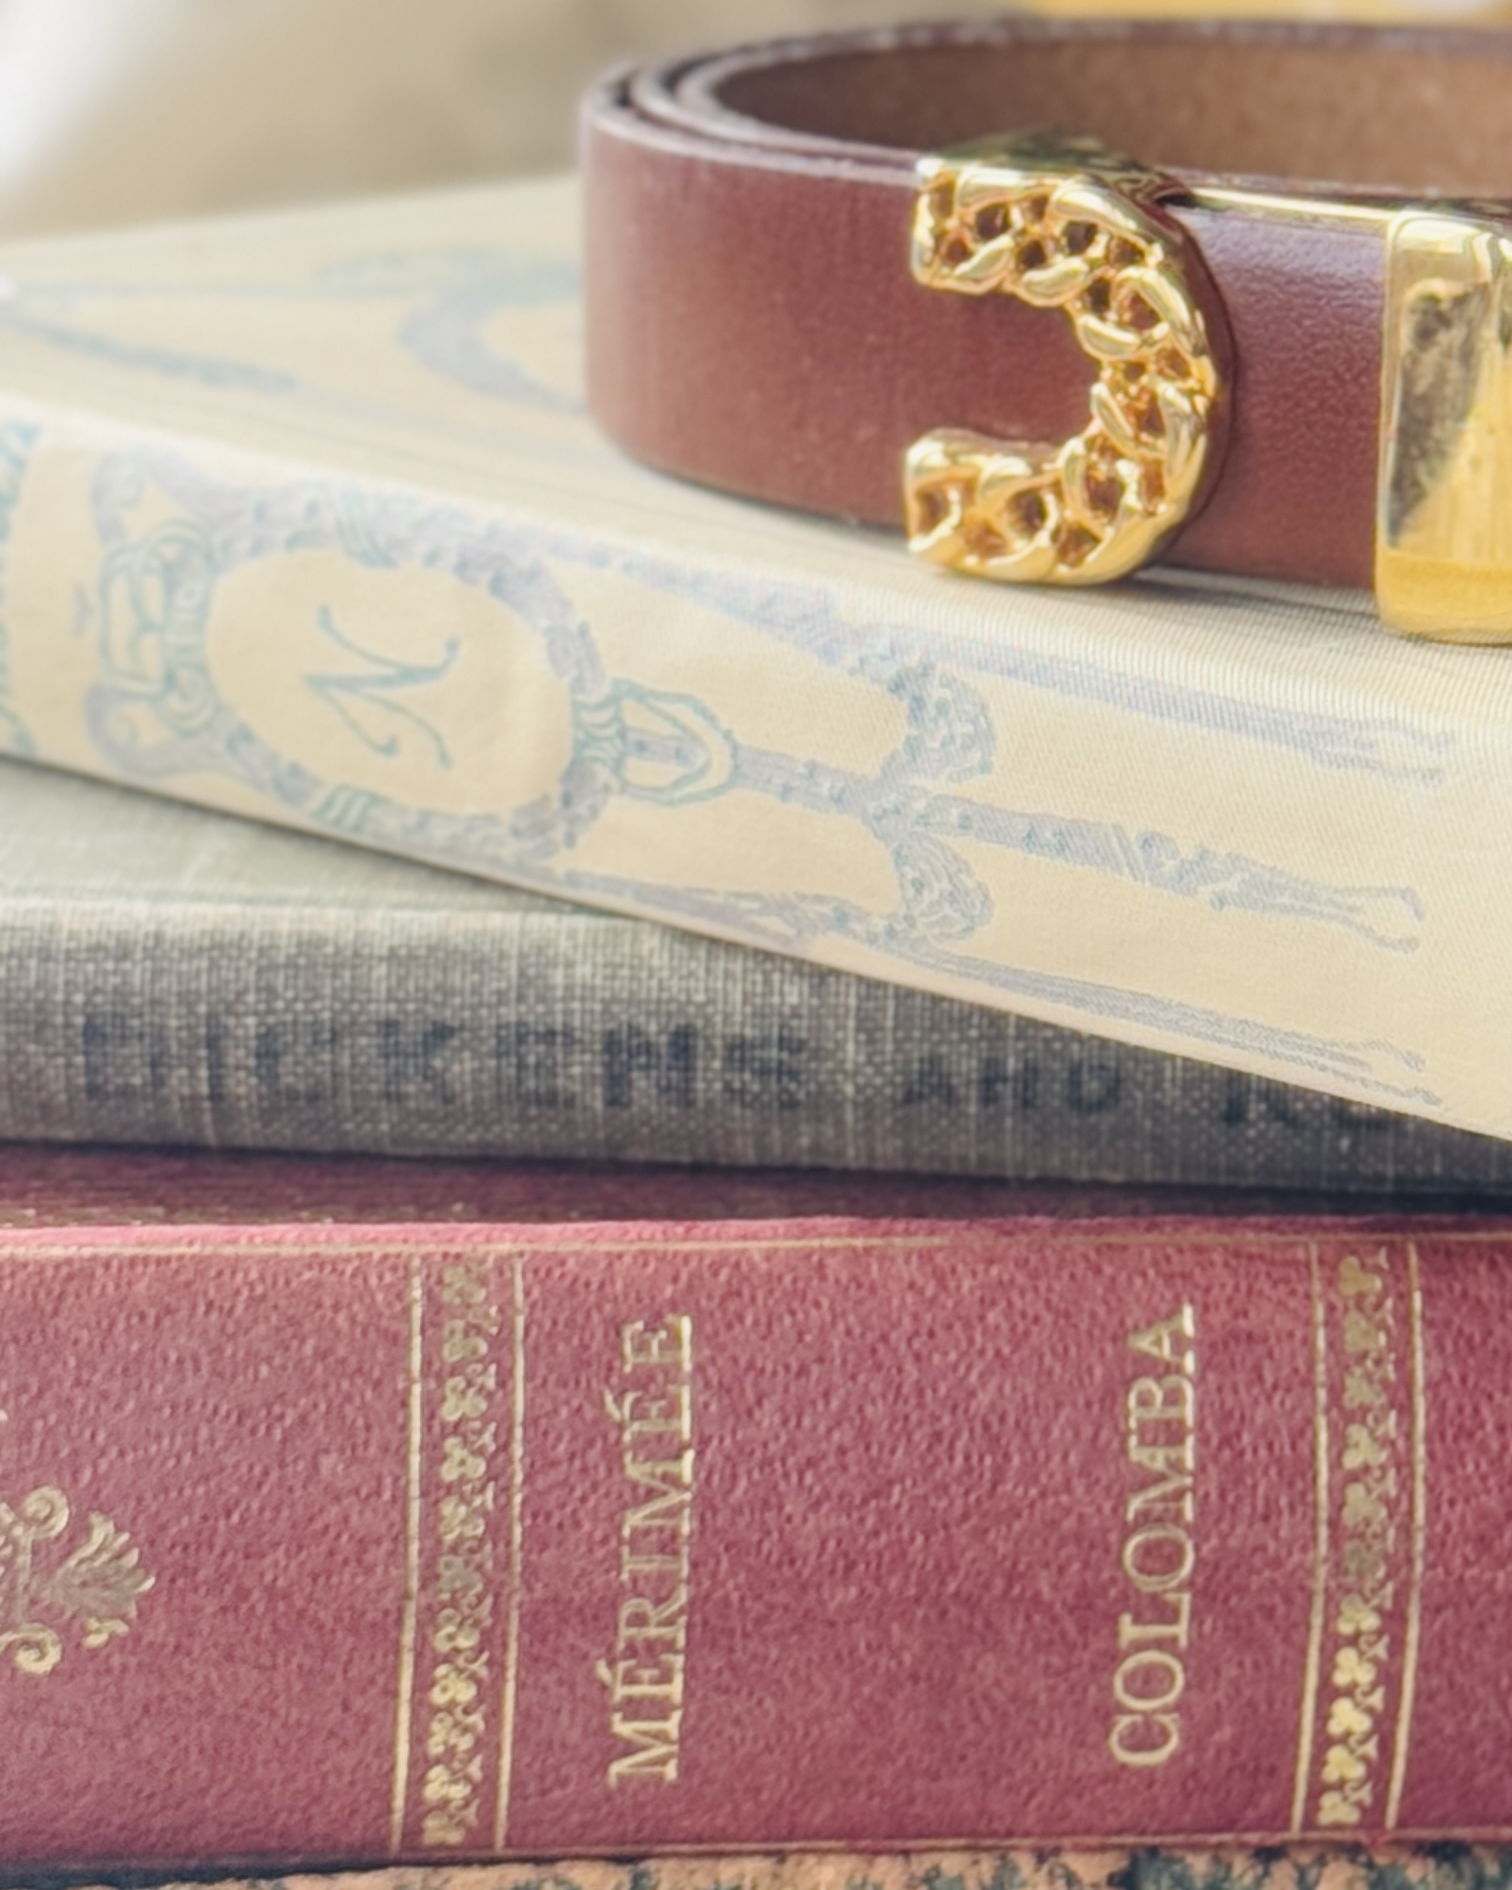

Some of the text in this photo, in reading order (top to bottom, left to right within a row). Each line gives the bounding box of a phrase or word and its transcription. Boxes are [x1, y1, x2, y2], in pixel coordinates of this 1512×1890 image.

[80, 1010, 1120, 1113] DICKENS AND
[597, 1313, 696, 1787] MÉRIMÉE
[1108, 1303, 1195, 1767] COLOMBA
